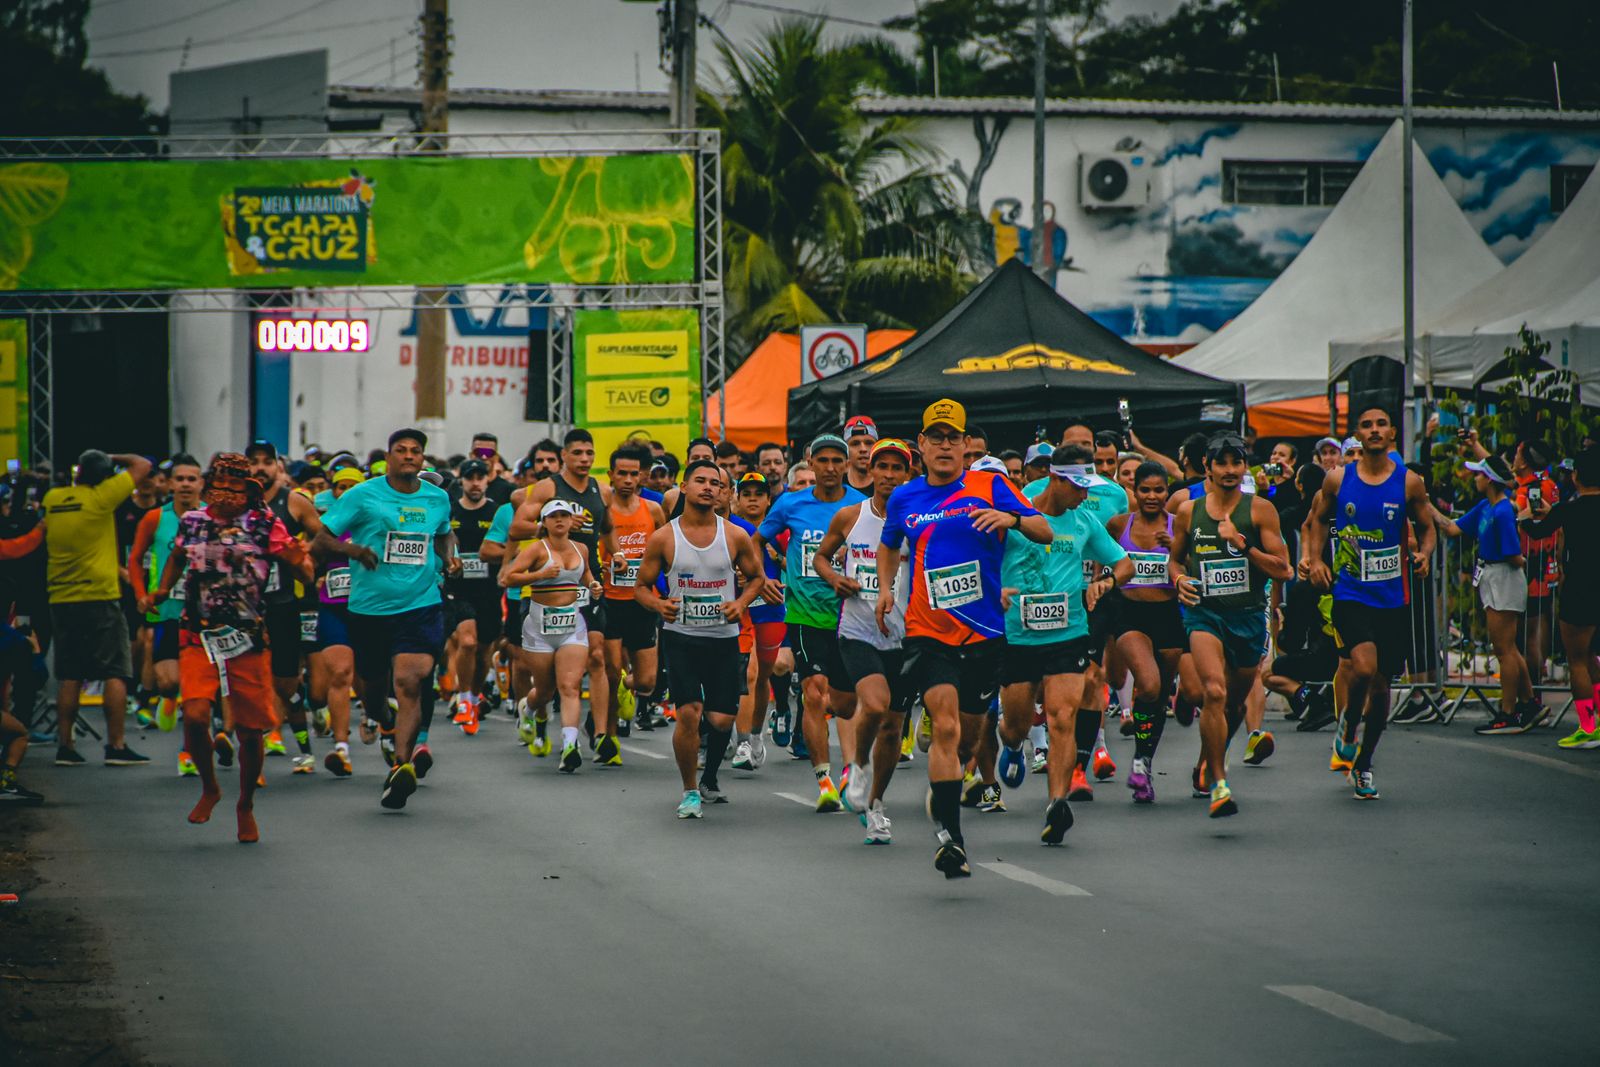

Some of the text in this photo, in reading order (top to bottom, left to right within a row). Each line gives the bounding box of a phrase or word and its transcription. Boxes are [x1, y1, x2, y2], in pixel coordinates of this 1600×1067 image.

[262, 195, 292, 213] MEIA
[295, 194, 360, 213] MARATONA
[266, 236, 359, 260] CRUZ
[597, 344, 678, 354] SUPLEMENTARIA
[801, 529, 825, 543] AD
[398, 542, 424, 554] 0880
[1137, 563, 1165, 574] 0626
[1375, 557, 1399, 570] 1039
[865, 575, 896, 591] 102
[1215, 570, 1245, 584] 0693
[943, 575, 977, 594] 1035
[693, 605, 720, 616] 1026
[1035, 605, 1065, 619] 0929
[552, 614, 575, 625] 0777
